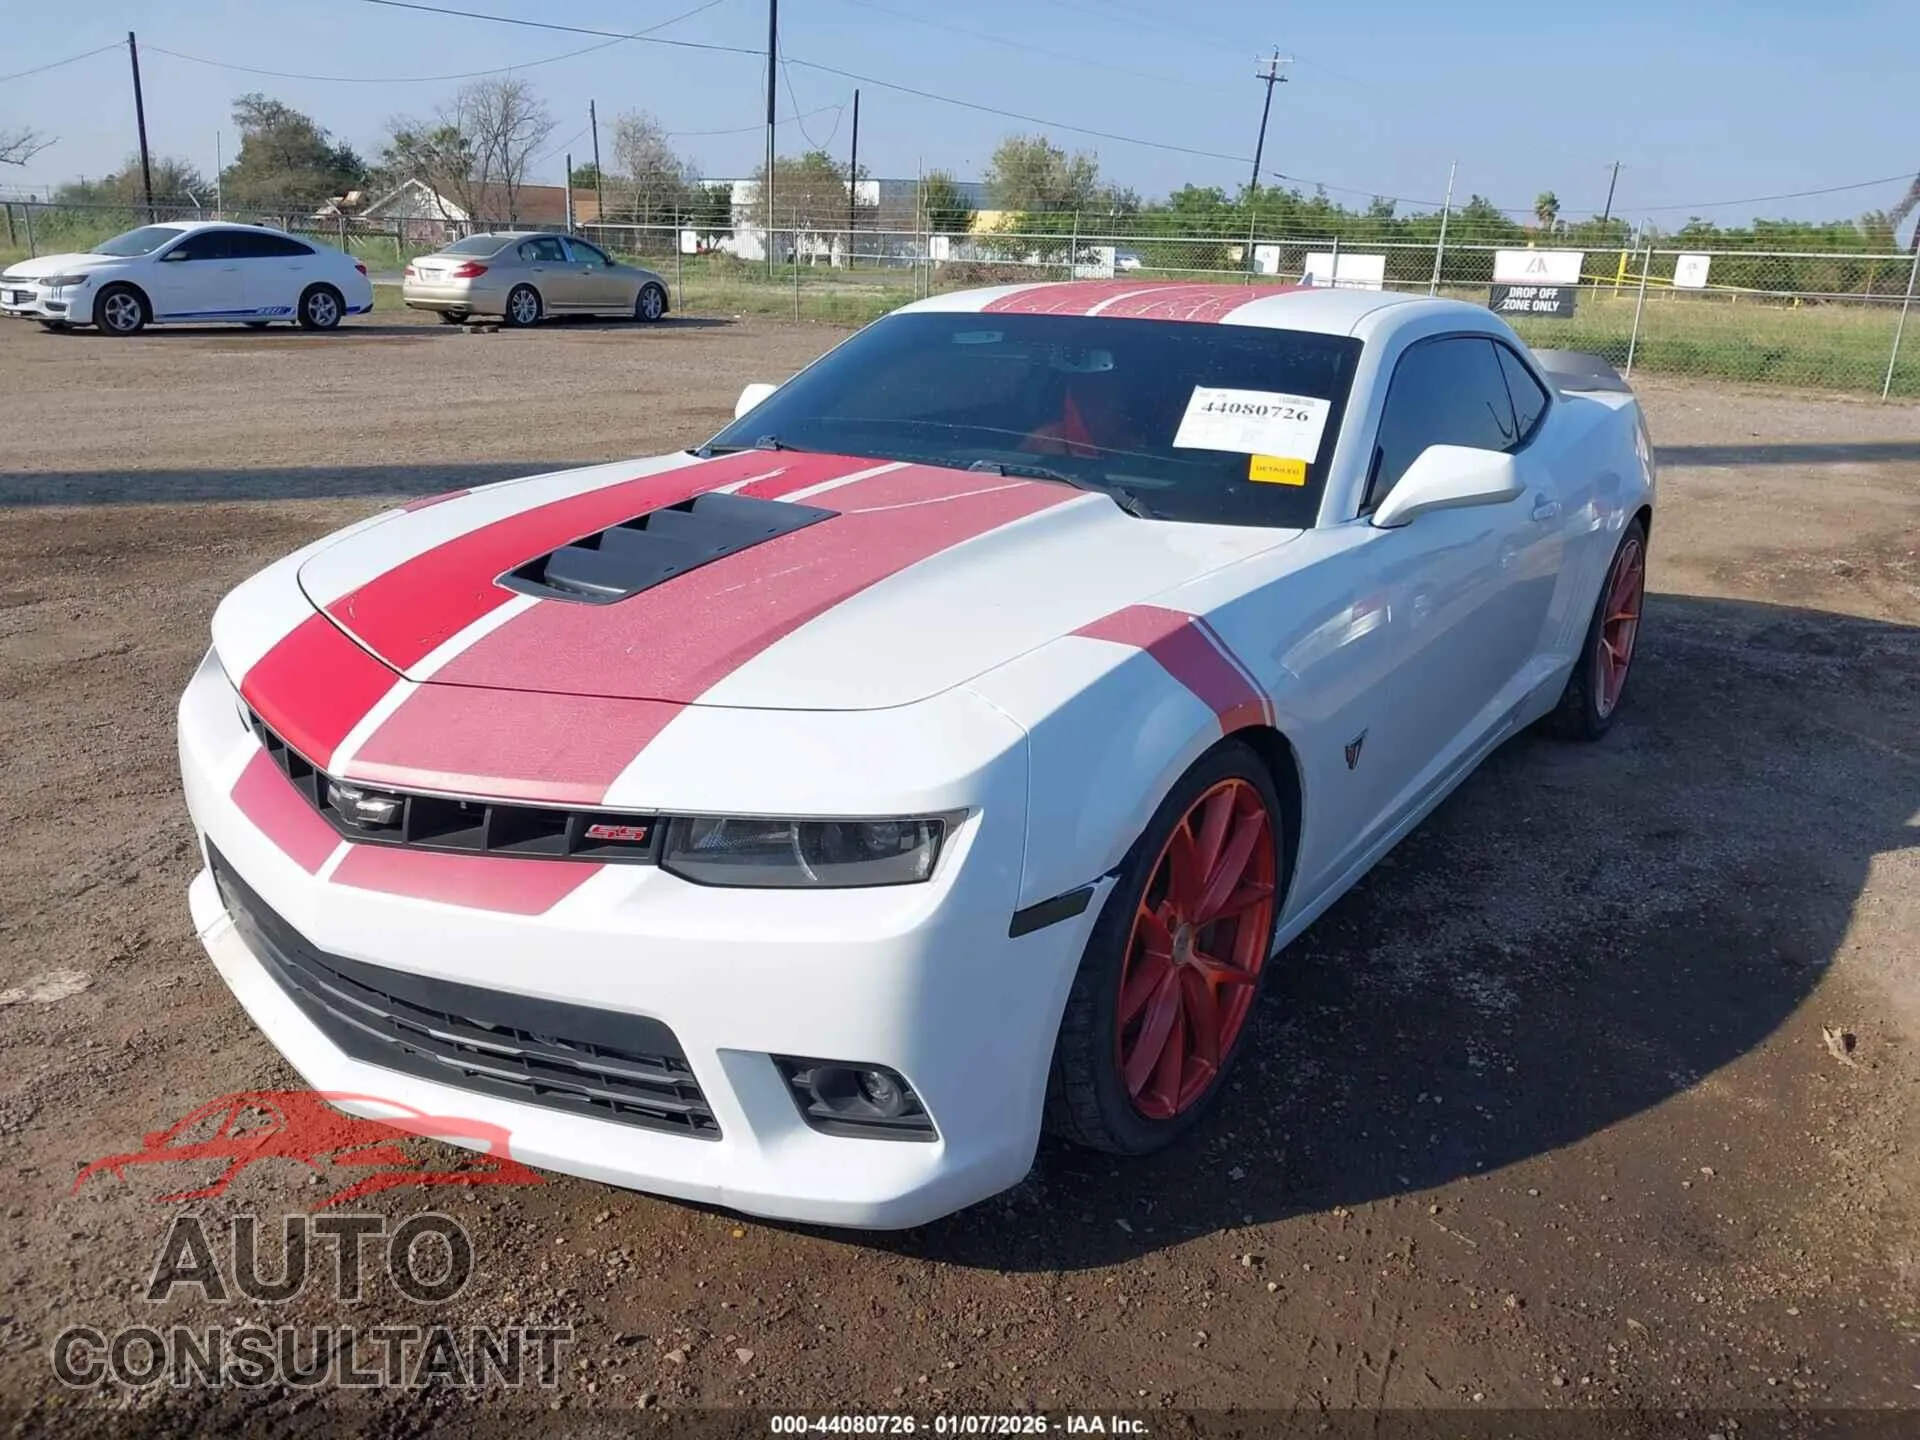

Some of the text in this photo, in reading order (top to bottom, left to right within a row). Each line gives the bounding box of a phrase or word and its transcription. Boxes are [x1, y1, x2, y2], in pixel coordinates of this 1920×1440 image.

[1509, 287, 1559, 299] DROP OFF
[1503, 299, 1560, 312] ZONE ONLY
[1201, 401, 1310, 422] 44080726
